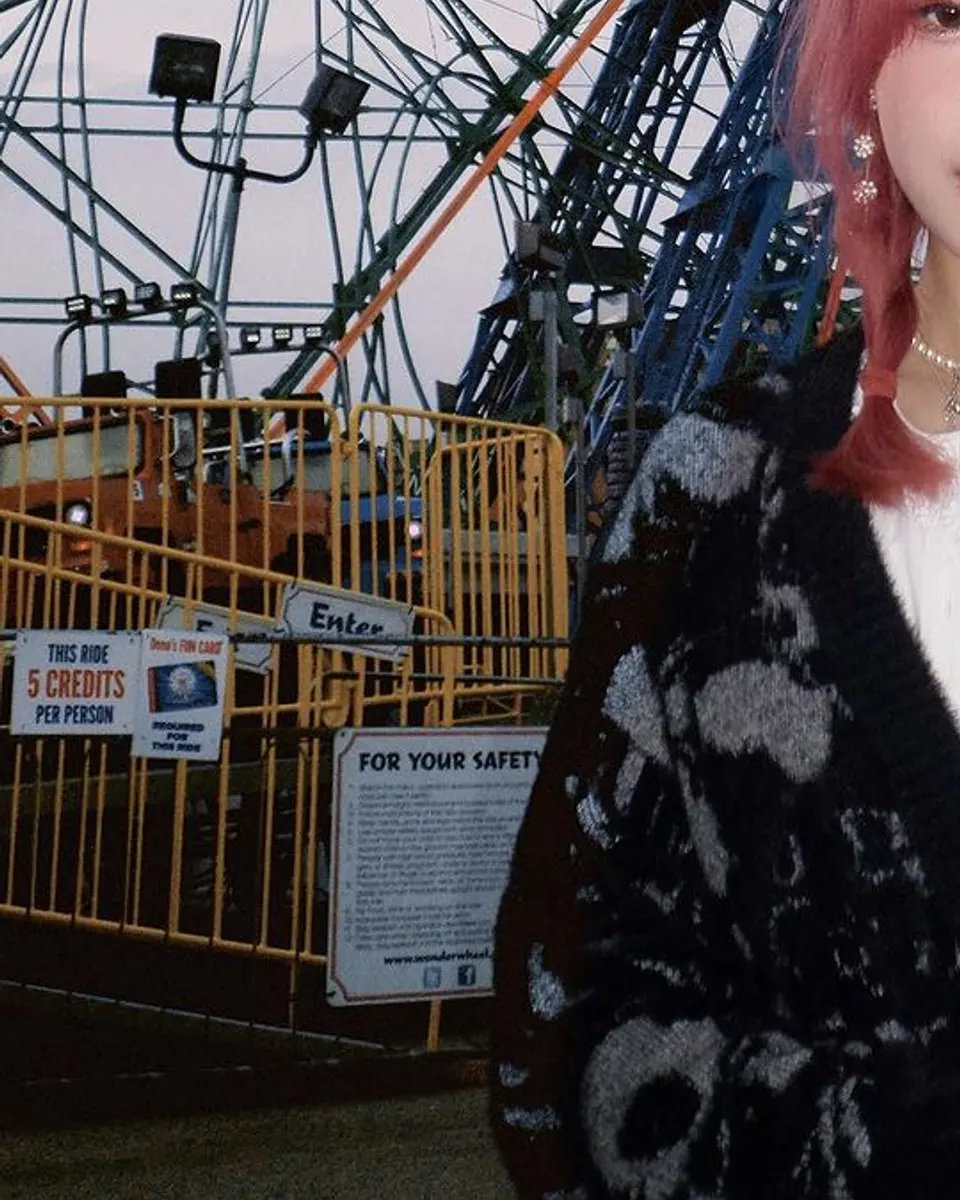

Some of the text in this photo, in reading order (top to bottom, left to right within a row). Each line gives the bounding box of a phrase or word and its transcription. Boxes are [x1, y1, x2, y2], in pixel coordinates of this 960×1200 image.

[310, 601, 384, 635] Enter
[48, 644, 109, 664] THIS RIDE
[28, 669, 125, 698] 5 CREDITS
[36, 704, 114, 724] PER PERSON
[152, 722, 204, 732] REQUIRED
[167, 733, 189, 741] FOR
[359, 752, 401, 771] FOR
[408, 752, 465, 771] YOUR
